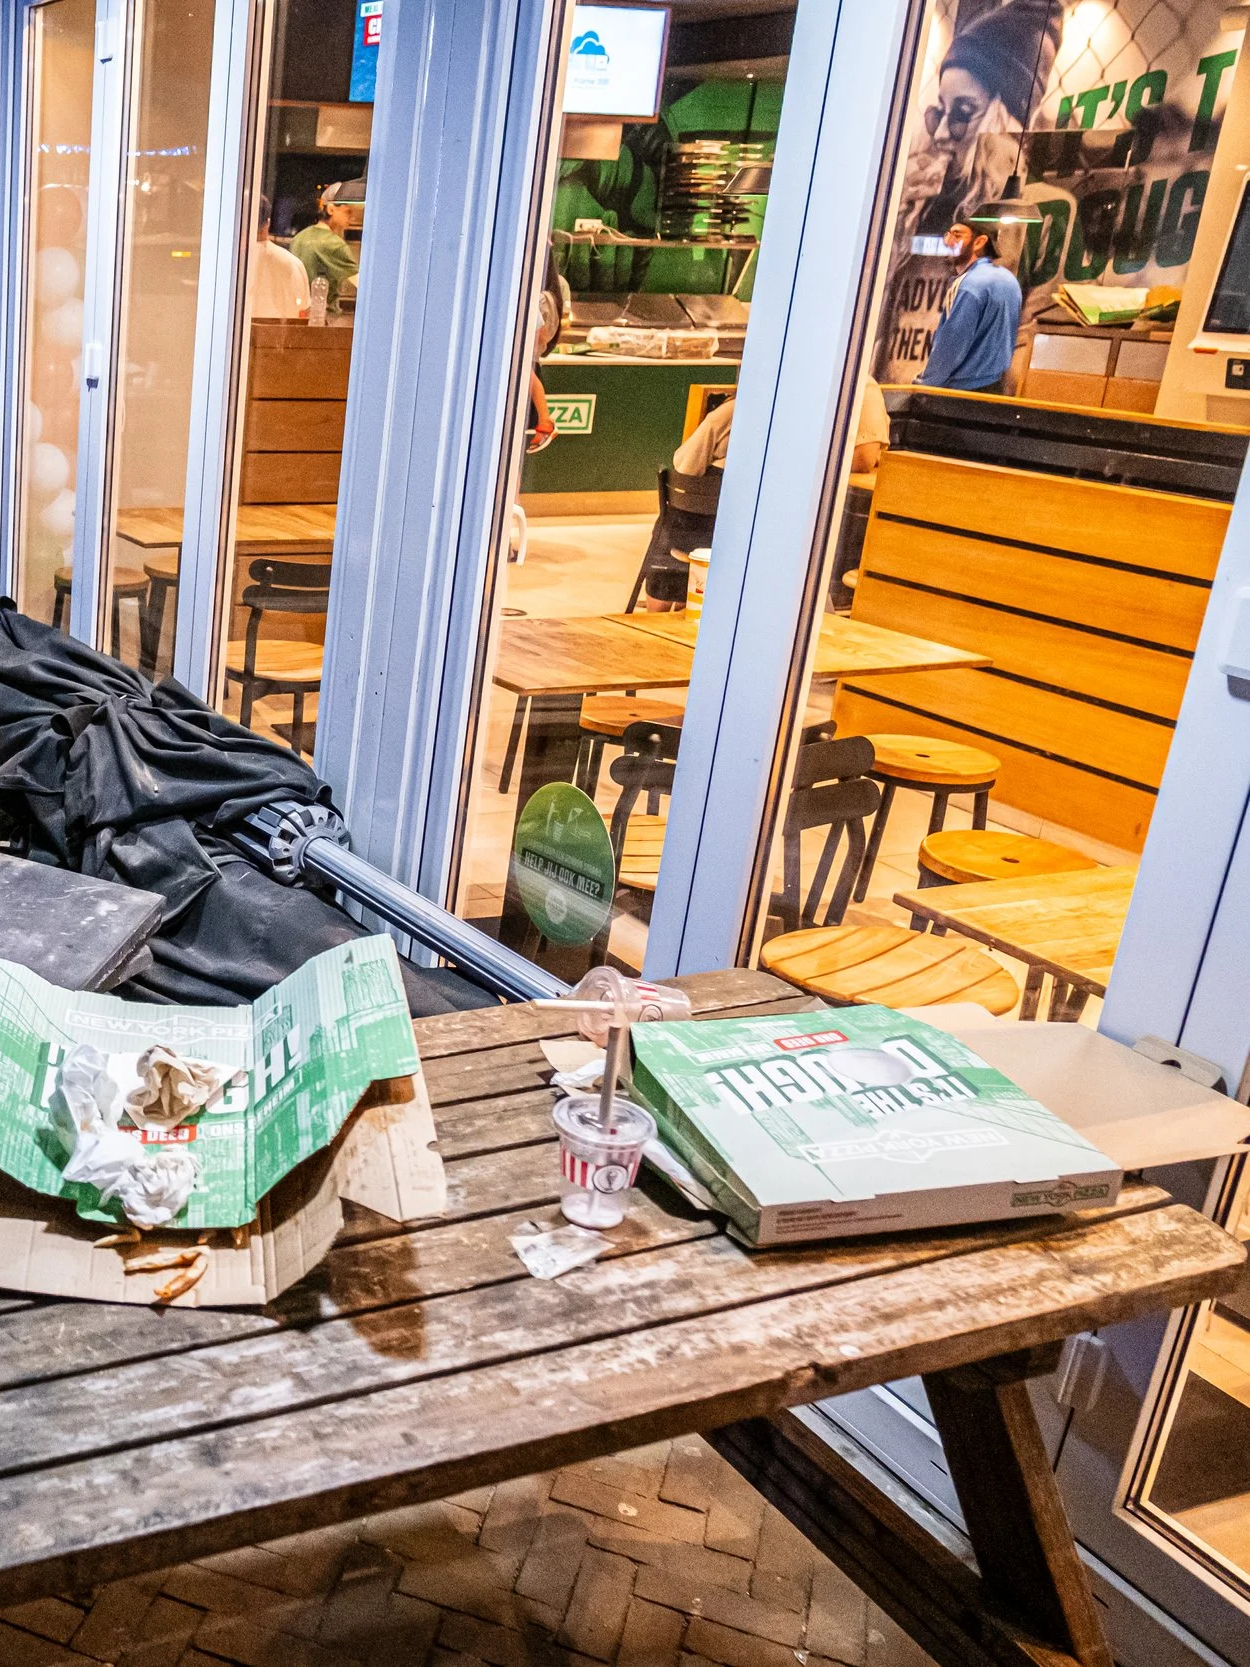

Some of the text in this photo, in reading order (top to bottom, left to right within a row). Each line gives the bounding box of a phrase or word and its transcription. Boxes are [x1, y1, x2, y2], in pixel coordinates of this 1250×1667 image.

[72, 1014, 133, 1031] NEW
[133, 1021, 202, 1038] YORK
[851, 1075, 977, 1118] IT'S THE
[806, 1130, 998, 1160] NEW YORK PIZZA
